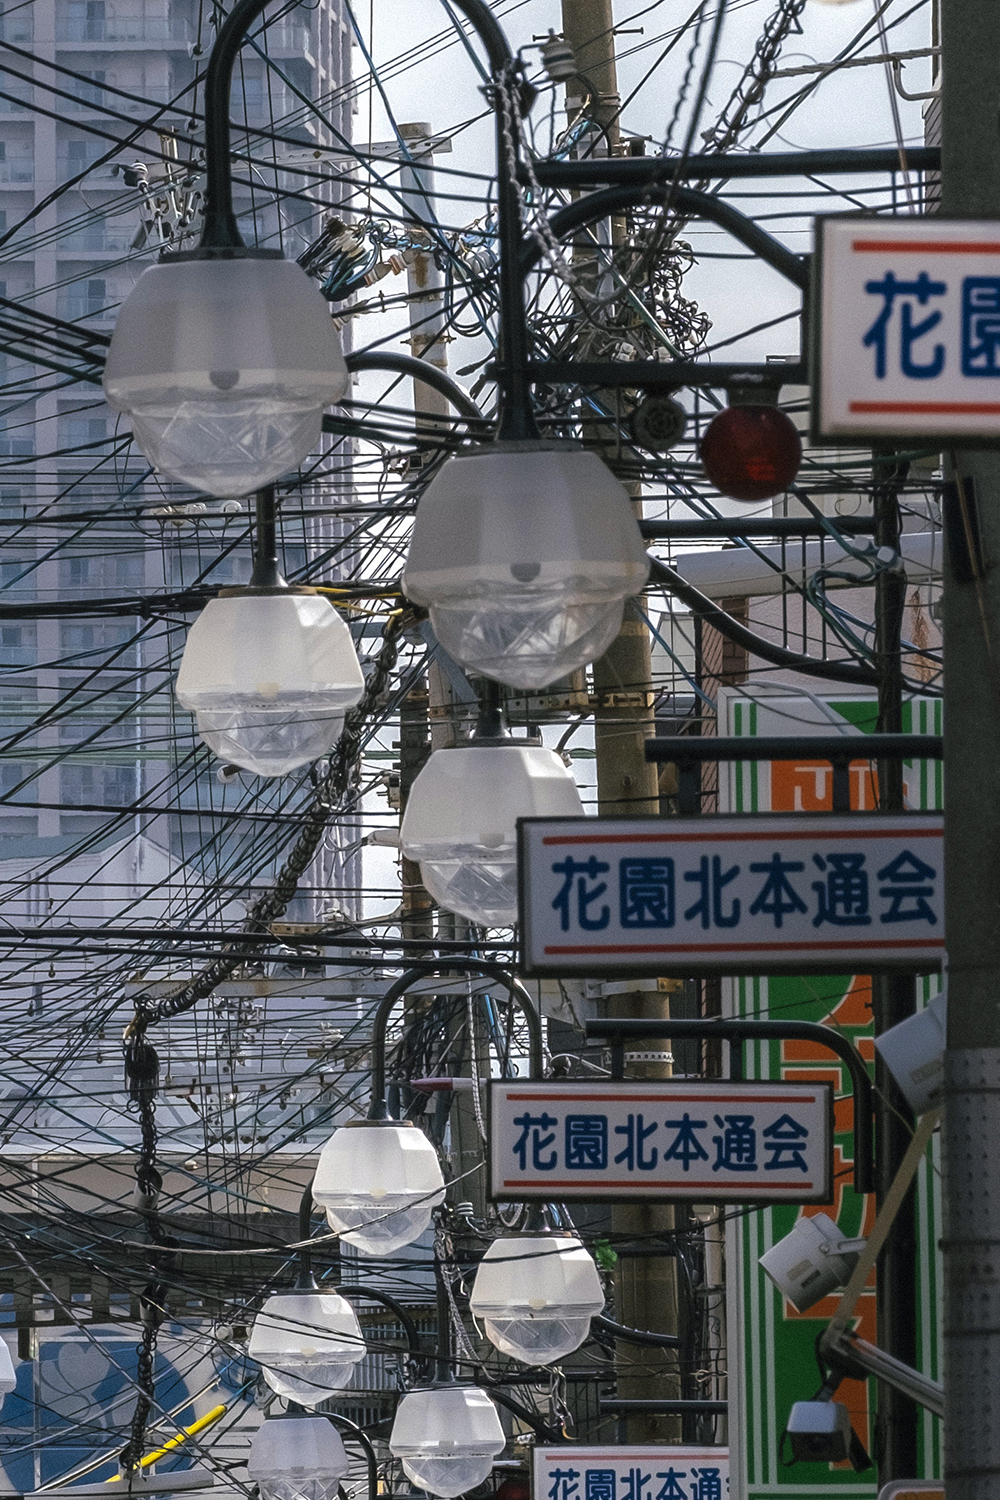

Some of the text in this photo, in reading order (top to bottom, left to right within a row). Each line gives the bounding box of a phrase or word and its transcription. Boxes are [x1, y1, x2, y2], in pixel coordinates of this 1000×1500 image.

[550, 850, 938, 933] 花園北本通会
[512, 1112, 810, 1174] 花園北本通会
